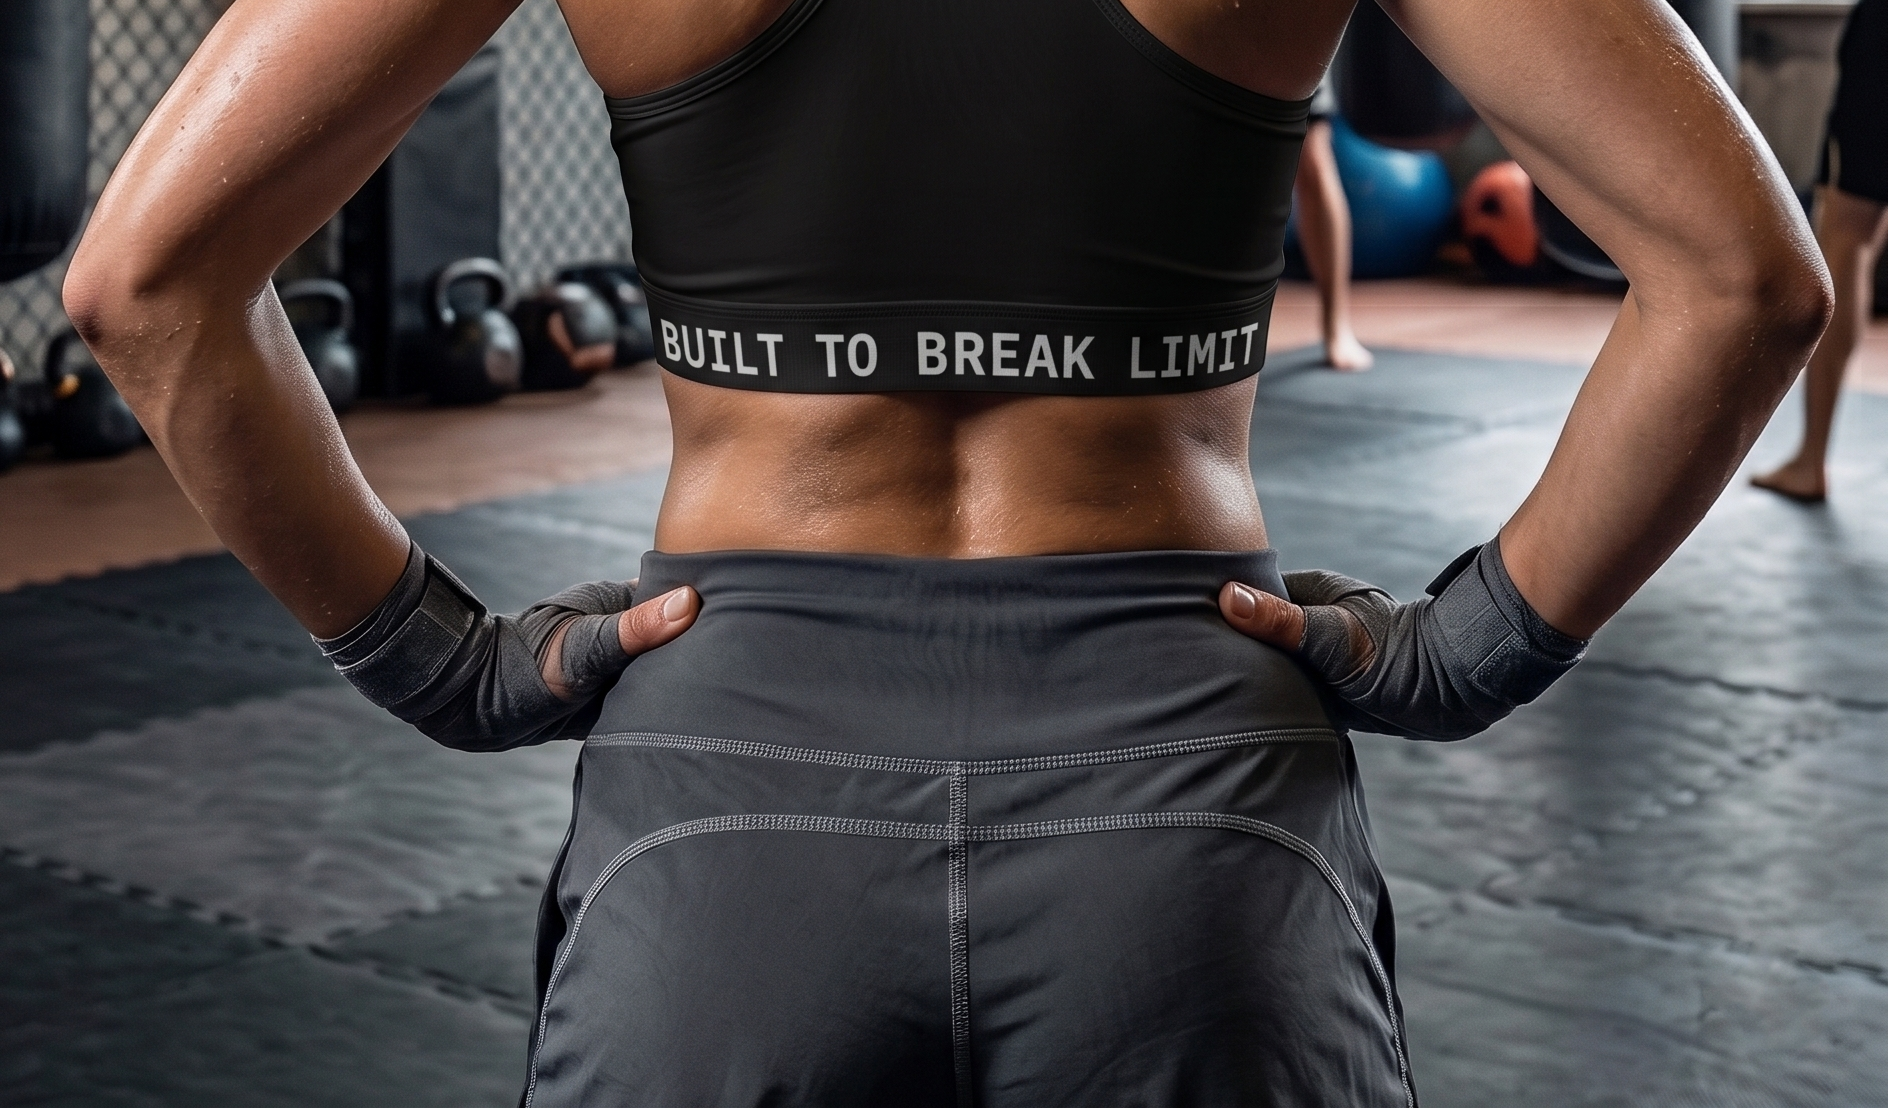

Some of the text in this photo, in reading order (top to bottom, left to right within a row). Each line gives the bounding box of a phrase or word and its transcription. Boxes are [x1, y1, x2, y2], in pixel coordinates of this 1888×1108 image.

[660, 318, 1259, 379] BUILT TO BREAK LIMIT
